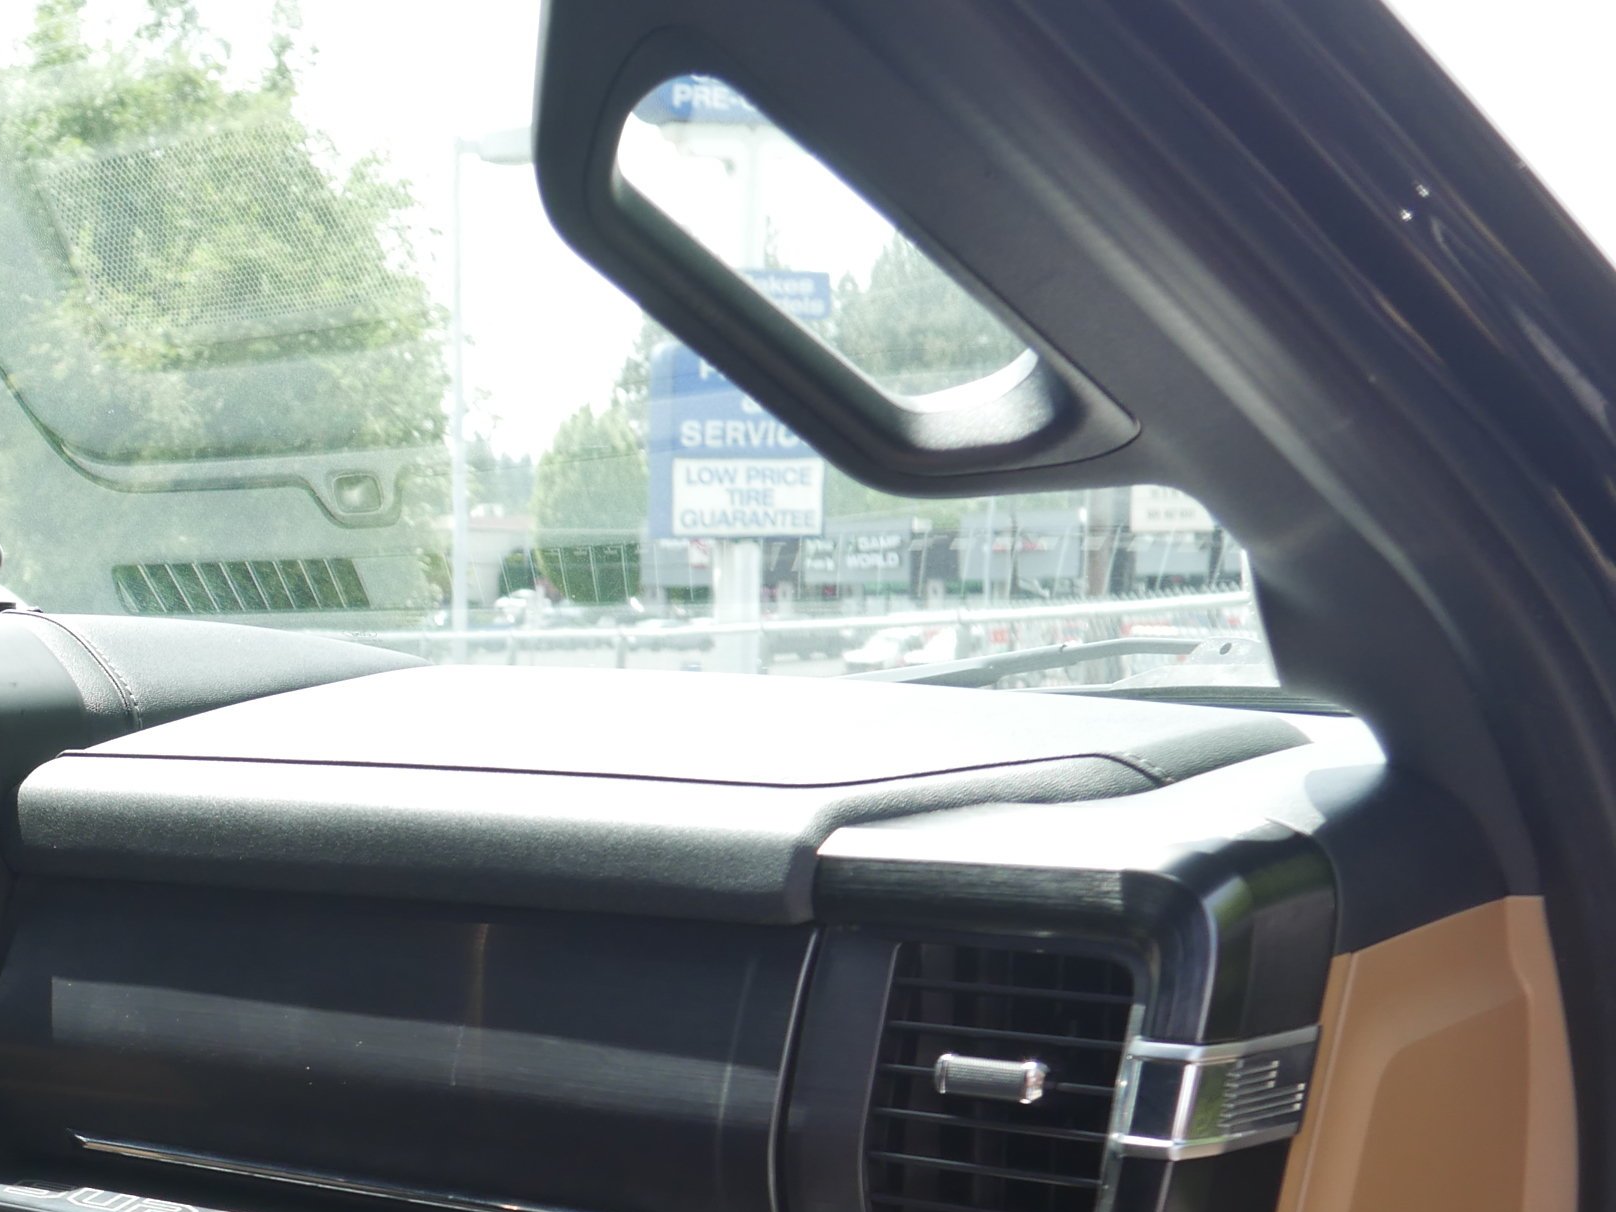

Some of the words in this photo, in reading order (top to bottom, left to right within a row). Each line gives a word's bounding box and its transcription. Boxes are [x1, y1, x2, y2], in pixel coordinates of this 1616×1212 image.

[680, 419, 804, 449] SERVIC
[686, 467, 737, 485] LOW
[747, 467, 812, 485] PRICE
[726, 488, 775, 507] TIRE
[680, 509, 816, 528] GUARANTEE
